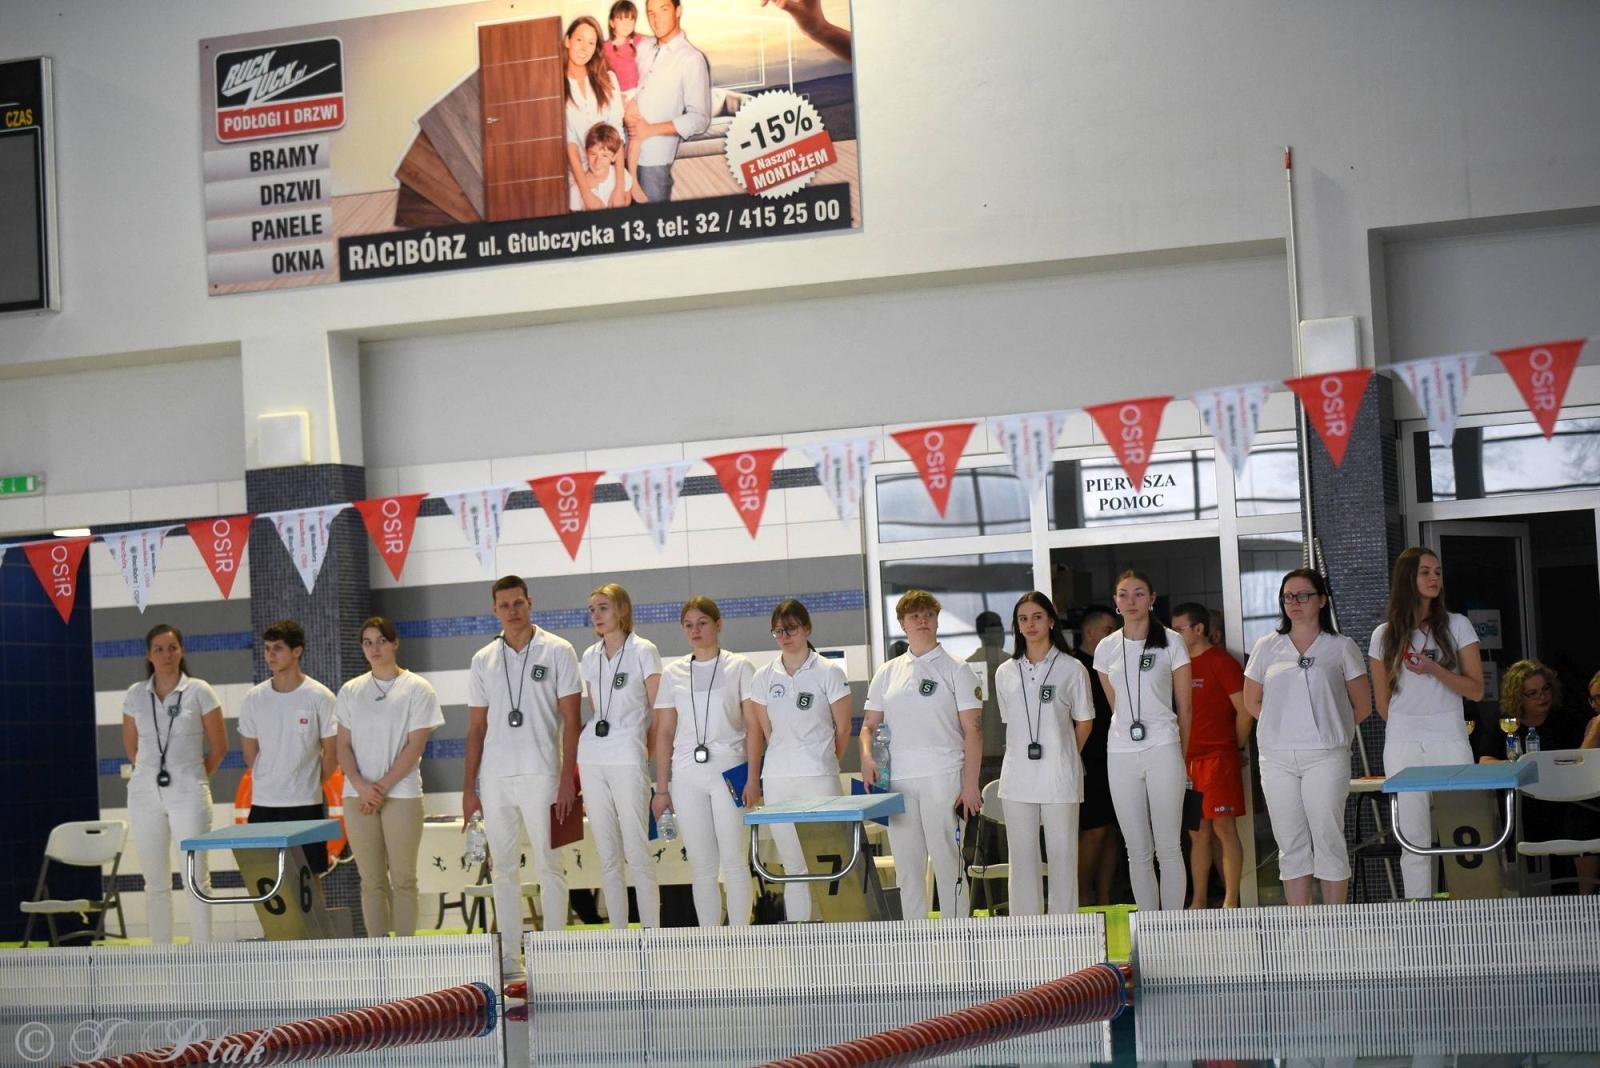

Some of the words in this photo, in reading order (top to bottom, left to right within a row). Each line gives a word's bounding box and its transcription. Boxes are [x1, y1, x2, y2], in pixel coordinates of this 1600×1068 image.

[222, 50, 277, 91] RUCK
[5, 109, 33, 127] CZAS
[223, 111, 281, 133] PODŁOGI
[284, 110, 290, 125] I
[294, 104, 338, 124] DRZWI
[740, 105, 813, 149] -15%
[249, 144, 319, 173] BRAMY
[749, 164, 756, 174] z
[756, 148, 797, 171] Naszym
[752, 148, 829, 190] MONTAŻEM
[260, 179, 322, 206] DRZWI
[251, 214, 323, 242] PANELE
[348, 231, 468, 272] RACIBÓRZ
[478, 238, 502, 257] ul.
[507, 225, 615, 253] Głubczycka
[620, 220, 652, 243] 13,
[656, 216, 689, 239] tel:
[695, 211, 720, 234] 32
[739, 206, 777, 229] 415
[783, 202, 808, 225] 25
[814, 199, 841, 221] 00
[272, 249, 325, 275] OKNA
[1529, 348, 1555, 411] OSiR
[1320, 375, 1347, 437] OSiR
[1119, 404, 1146, 465] OSiR
[924, 431, 948, 490] OSiR
[735, 453, 761, 512] OSiR
[1099, 494, 1165, 511] POMOC
[382, 499, 404, 554] OSiR
[556, 476, 581, 534] OSiR
[212, 519, 234, 574] OSiR
[50, 545, 72, 598] OSiR
[1453, 826, 1483, 869] 8
[816, 855, 842, 895] 7
